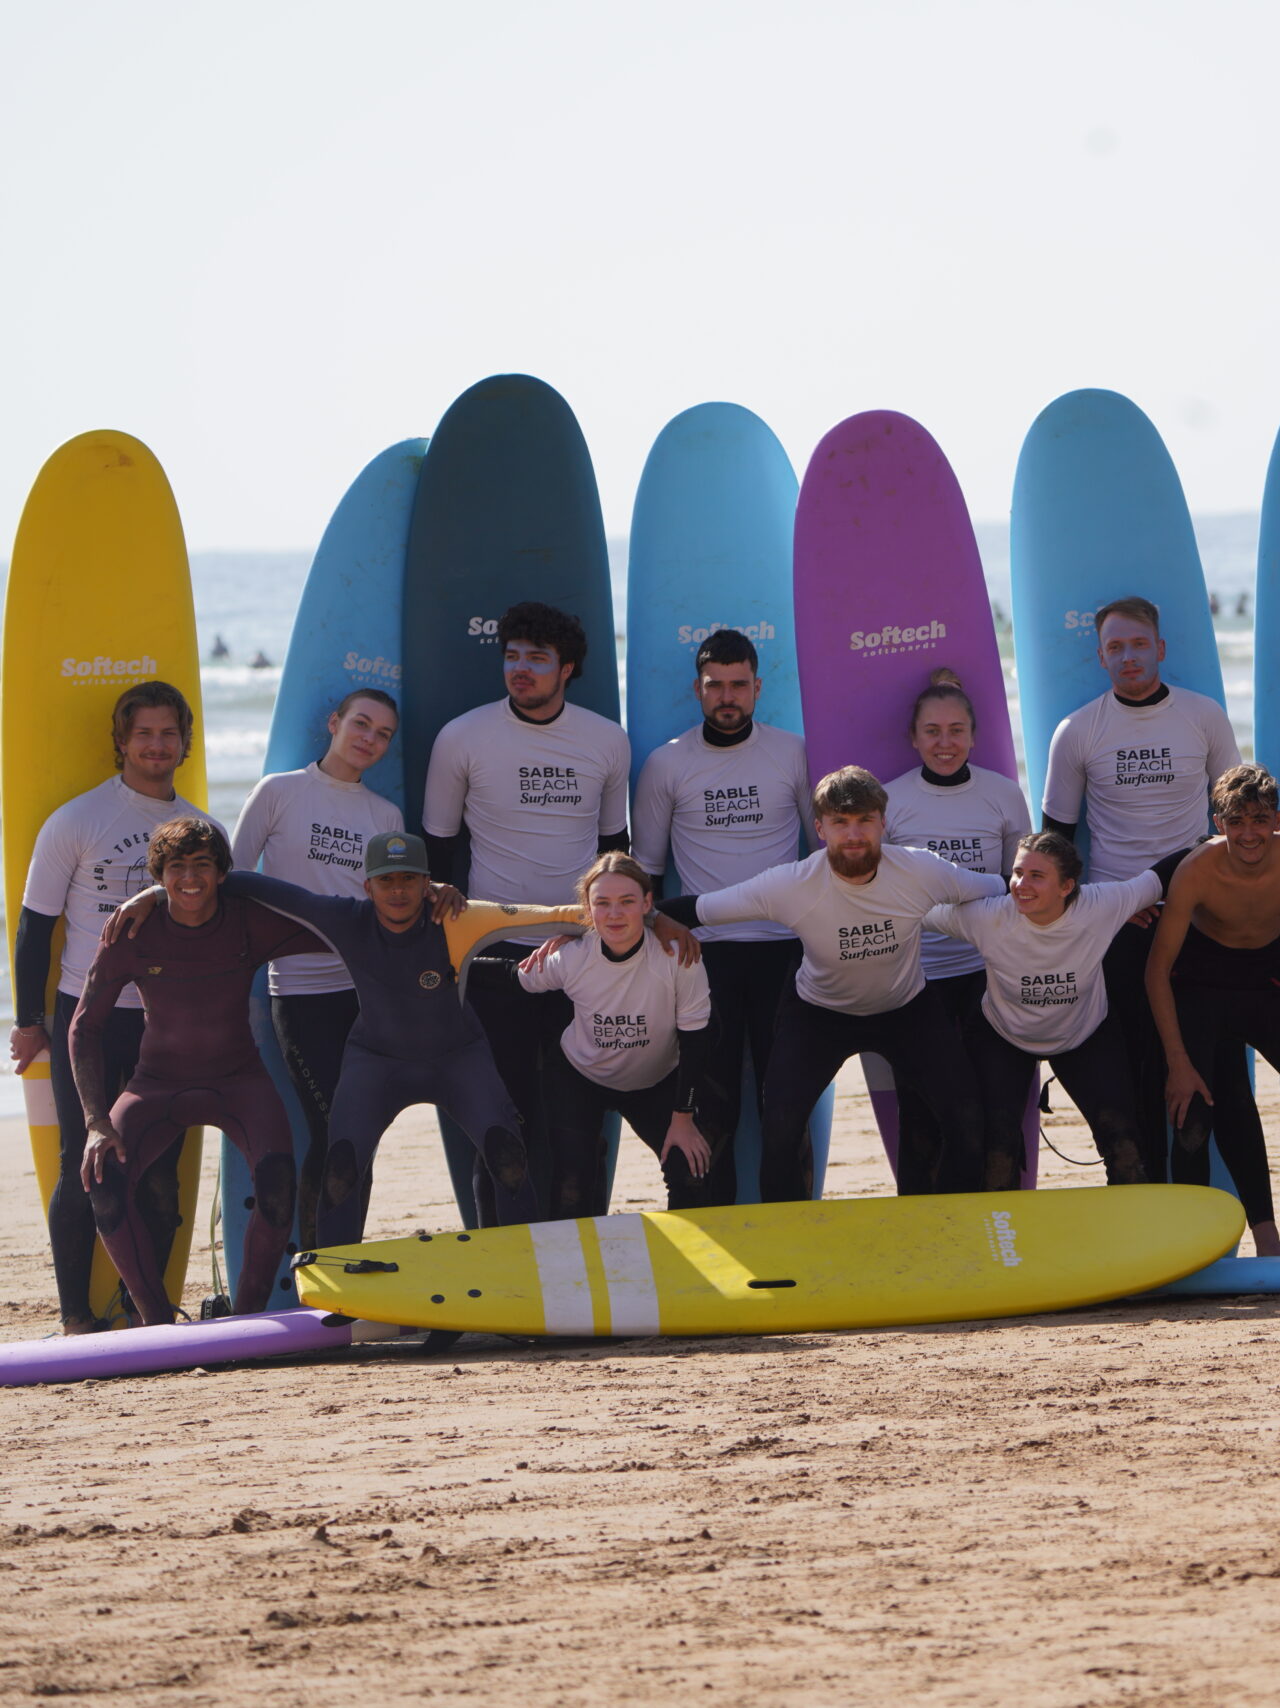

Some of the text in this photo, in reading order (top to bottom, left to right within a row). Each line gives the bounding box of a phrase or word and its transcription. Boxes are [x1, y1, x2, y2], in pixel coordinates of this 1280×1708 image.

[678, 620, 775, 645] Soch
[850, 620, 947, 651] Softech
[862, 641, 937, 658] softboards
[61, 655, 158, 677] Softech
[343, 651, 401, 680] Softe
[1116, 748, 1171, 761] SABLE
[519, 767, 576, 778] SABLE
[1116, 760, 1172, 773] BEACH
[520, 779, 578, 791] BEACH
[1115, 772, 1175, 787] Surfcamp
[520, 792, 582, 807] Surfcamp
[703, 785, 758, 801] SABLE
[705, 798, 760, 813] BEACH
[705, 812, 764, 828] Surfcamp
[311, 823, 363, 844] SABLE
[113, 832, 150, 854] TOES
[310, 834, 363, 856] BEACH
[927, 838, 981, 851] SABLE
[307, 847, 363, 871] Surfcamp
[939, 850, 983, 863] EACH
[98, 903, 117, 913] SAB
[838, 919, 893, 938] SABLE
[839, 930, 896, 950] BEACH
[839, 943, 899, 961] Surfcamp
[1021, 972, 1076, 986] SABLE
[1021, 984, 1077, 997] BEACH
[1021, 995, 1079, 1008] Surfcamp
[593, 1013, 646, 1026] SABLE
[593, 1026, 647, 1038] BEACH
[595, 1037, 650, 1050] Surfcamp
[992, 1210, 1023, 1267] Softech
